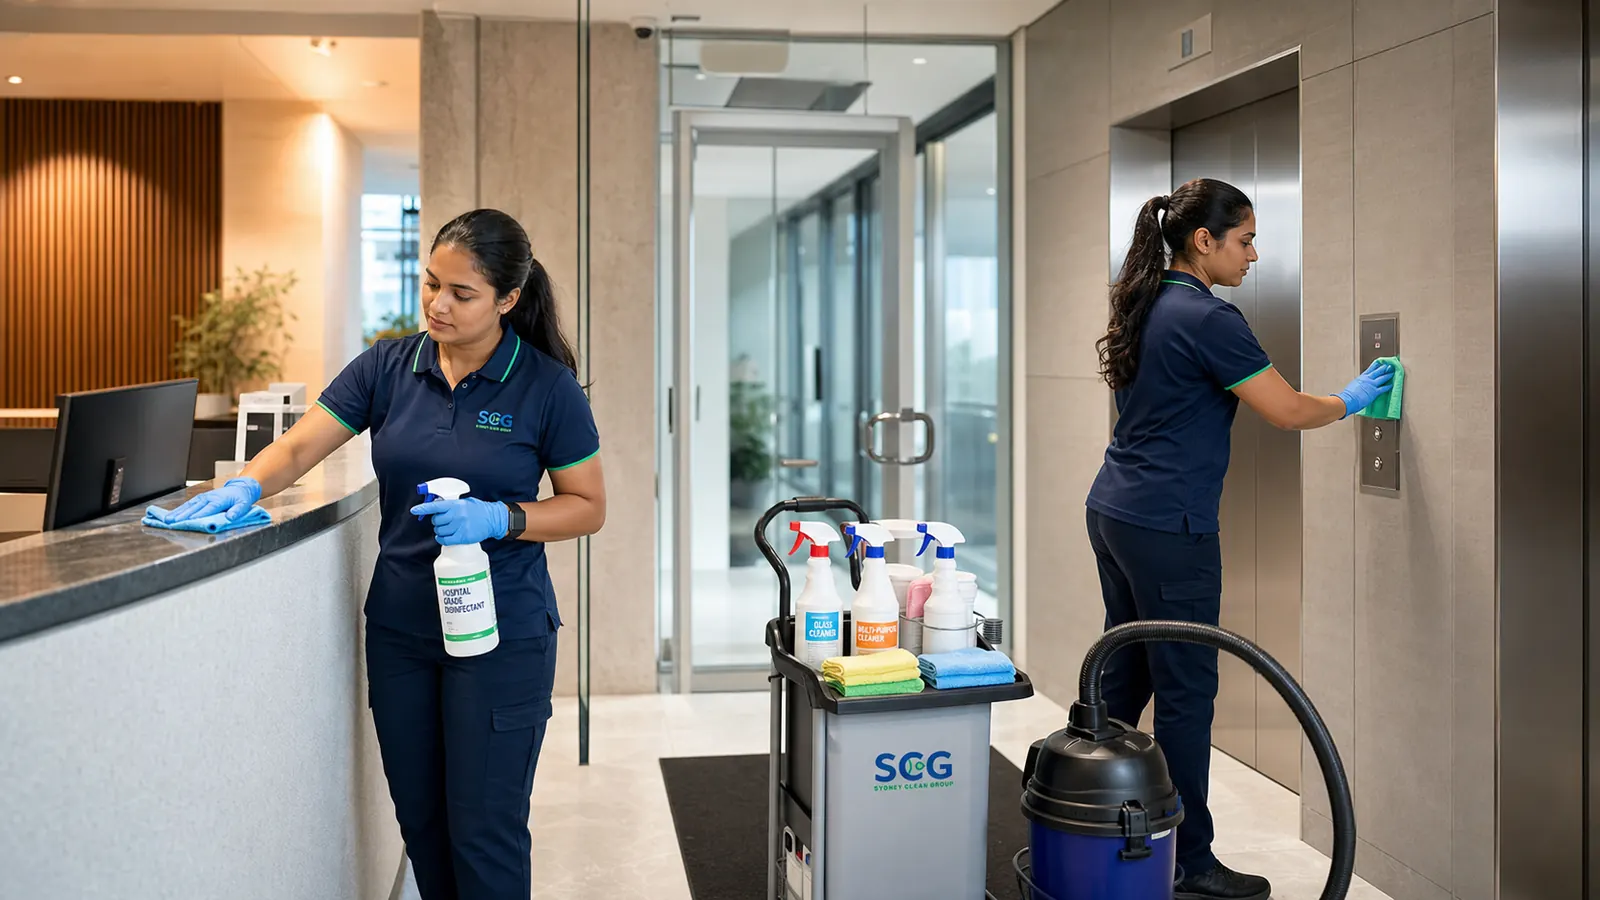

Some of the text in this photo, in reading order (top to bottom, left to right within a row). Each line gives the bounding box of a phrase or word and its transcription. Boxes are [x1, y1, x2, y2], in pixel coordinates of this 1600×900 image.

[478, 410, 513, 428] SCG
[875, 750, 953, 783] SCG
[873, 780, 954, 792] SYDNEY CLEAN GROUP
